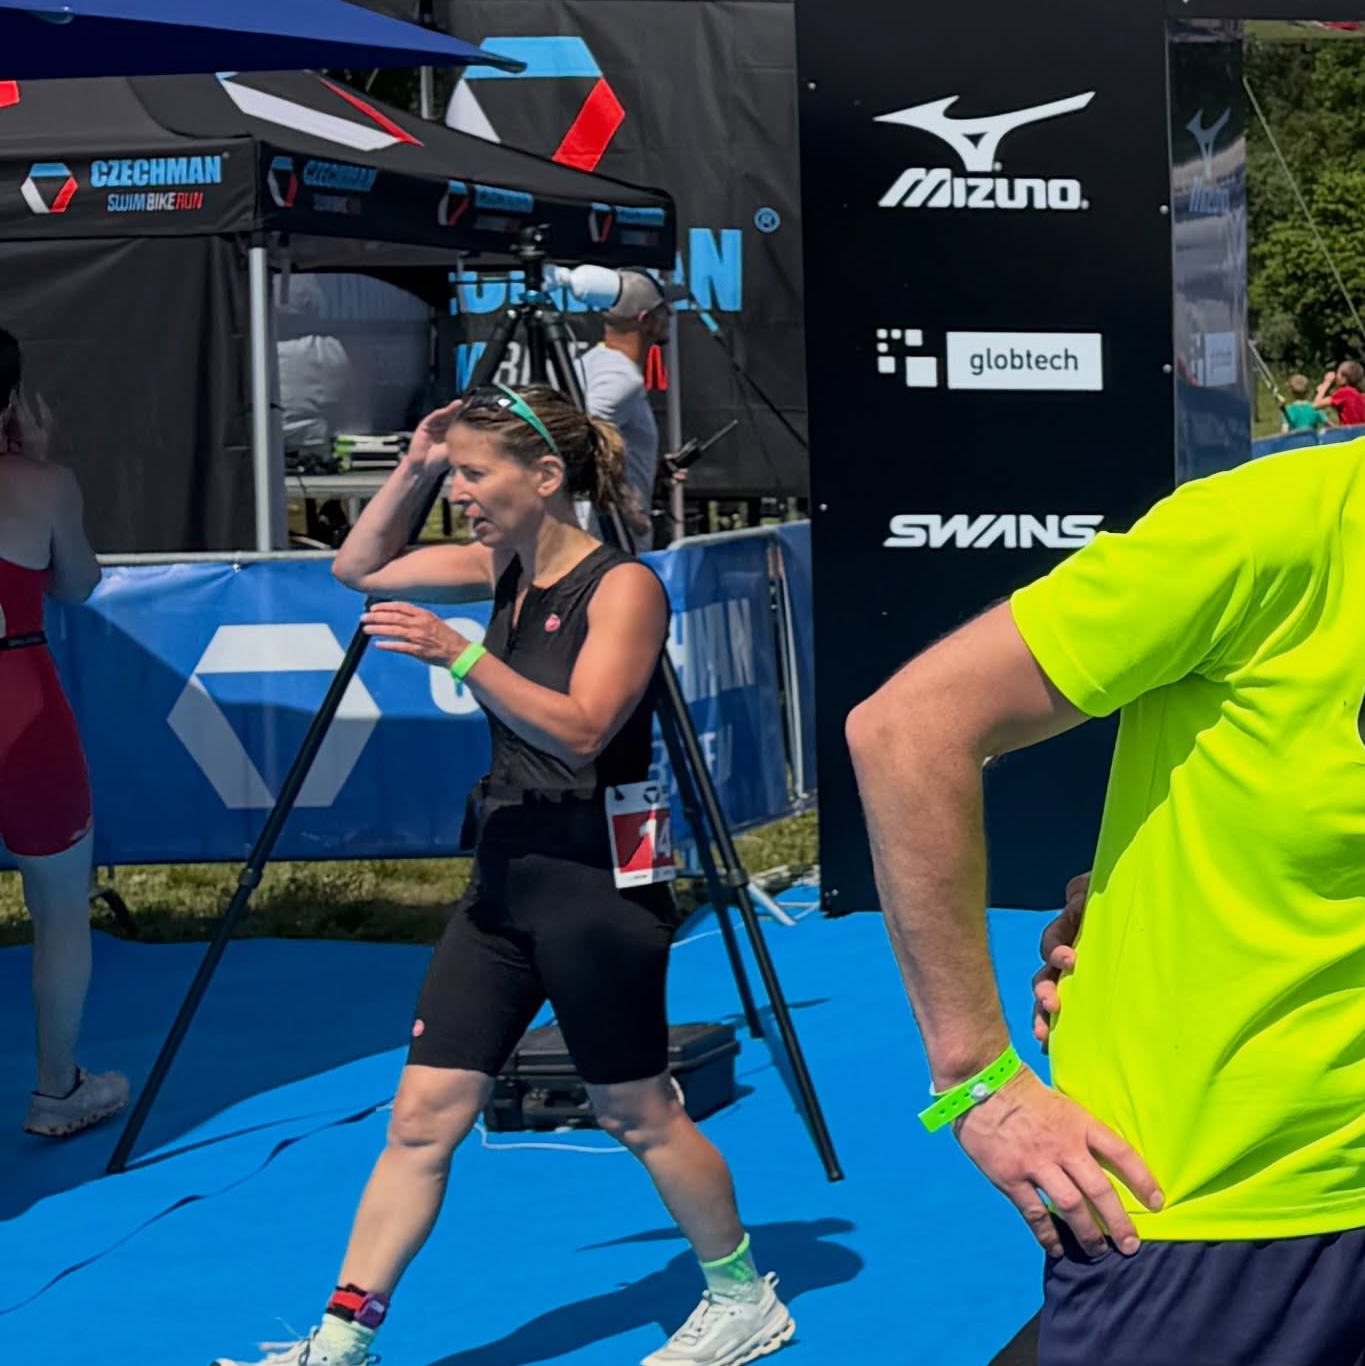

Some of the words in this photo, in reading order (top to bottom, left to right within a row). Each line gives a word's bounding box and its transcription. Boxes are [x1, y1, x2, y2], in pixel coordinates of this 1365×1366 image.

[90, 155, 221, 187] CZECHMAN
[969, 347, 1080, 378] globtech
[883, 514, 1104, 548] SWANS
